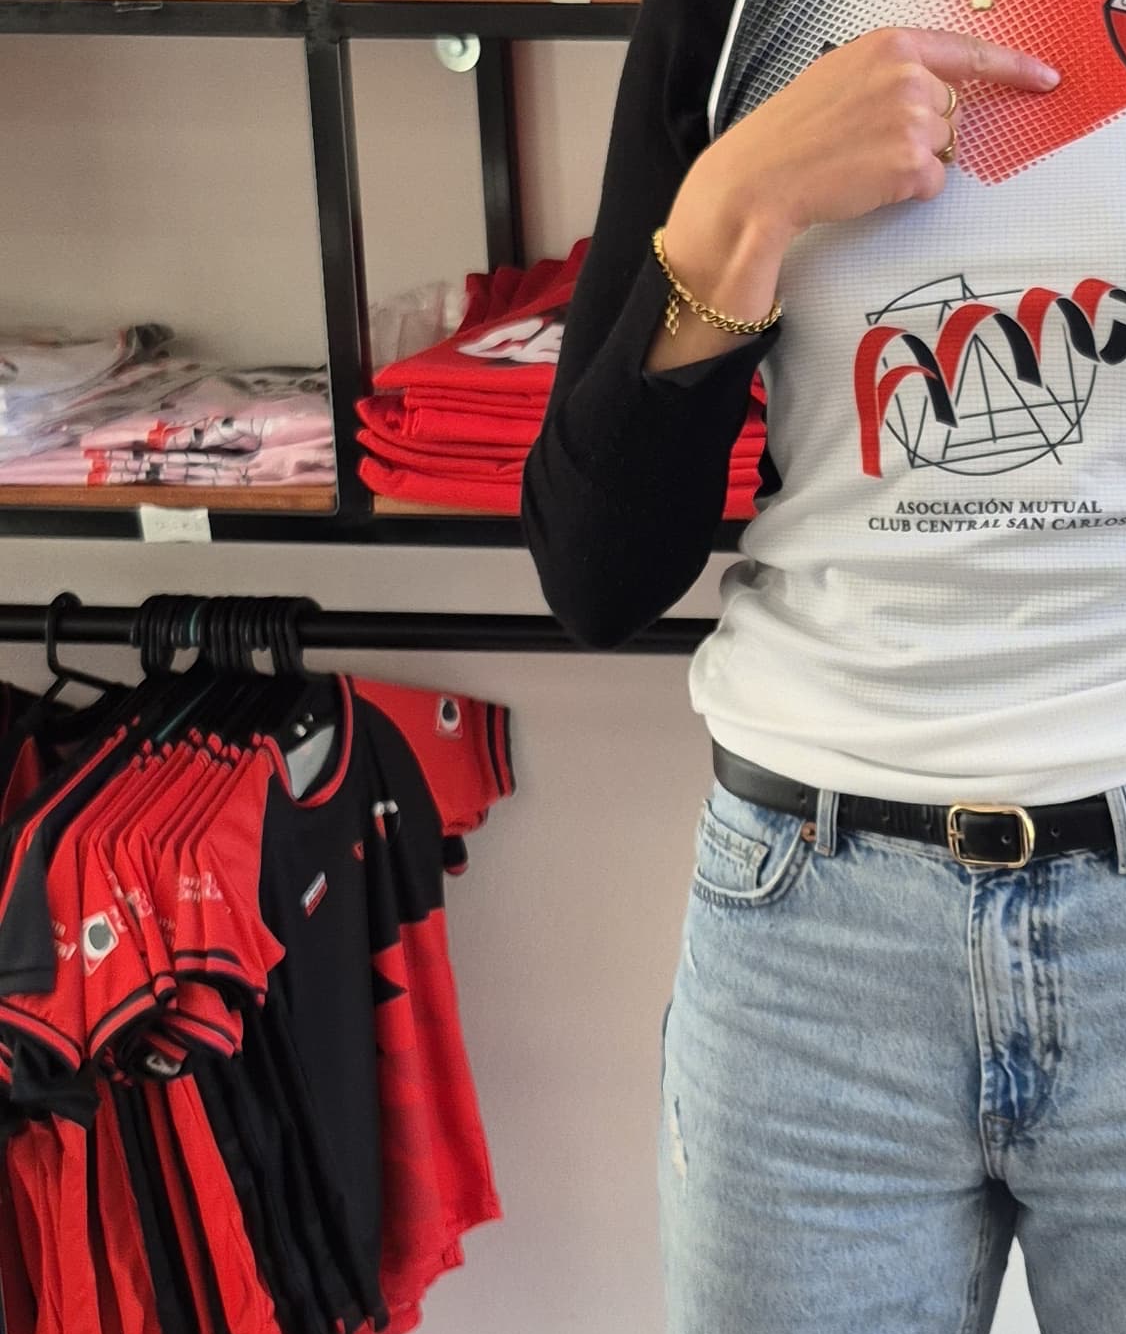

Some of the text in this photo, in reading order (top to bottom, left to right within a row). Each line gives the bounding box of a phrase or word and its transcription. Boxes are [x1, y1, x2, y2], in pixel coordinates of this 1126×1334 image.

[895, 498, 1103, 515] ASOCIACIÓN MUTUAL
[868, 517, 912, 532] CLUB
[915, 517, 1001, 533] CENTRAL
[1006, 517, 1045, 531] SAN
